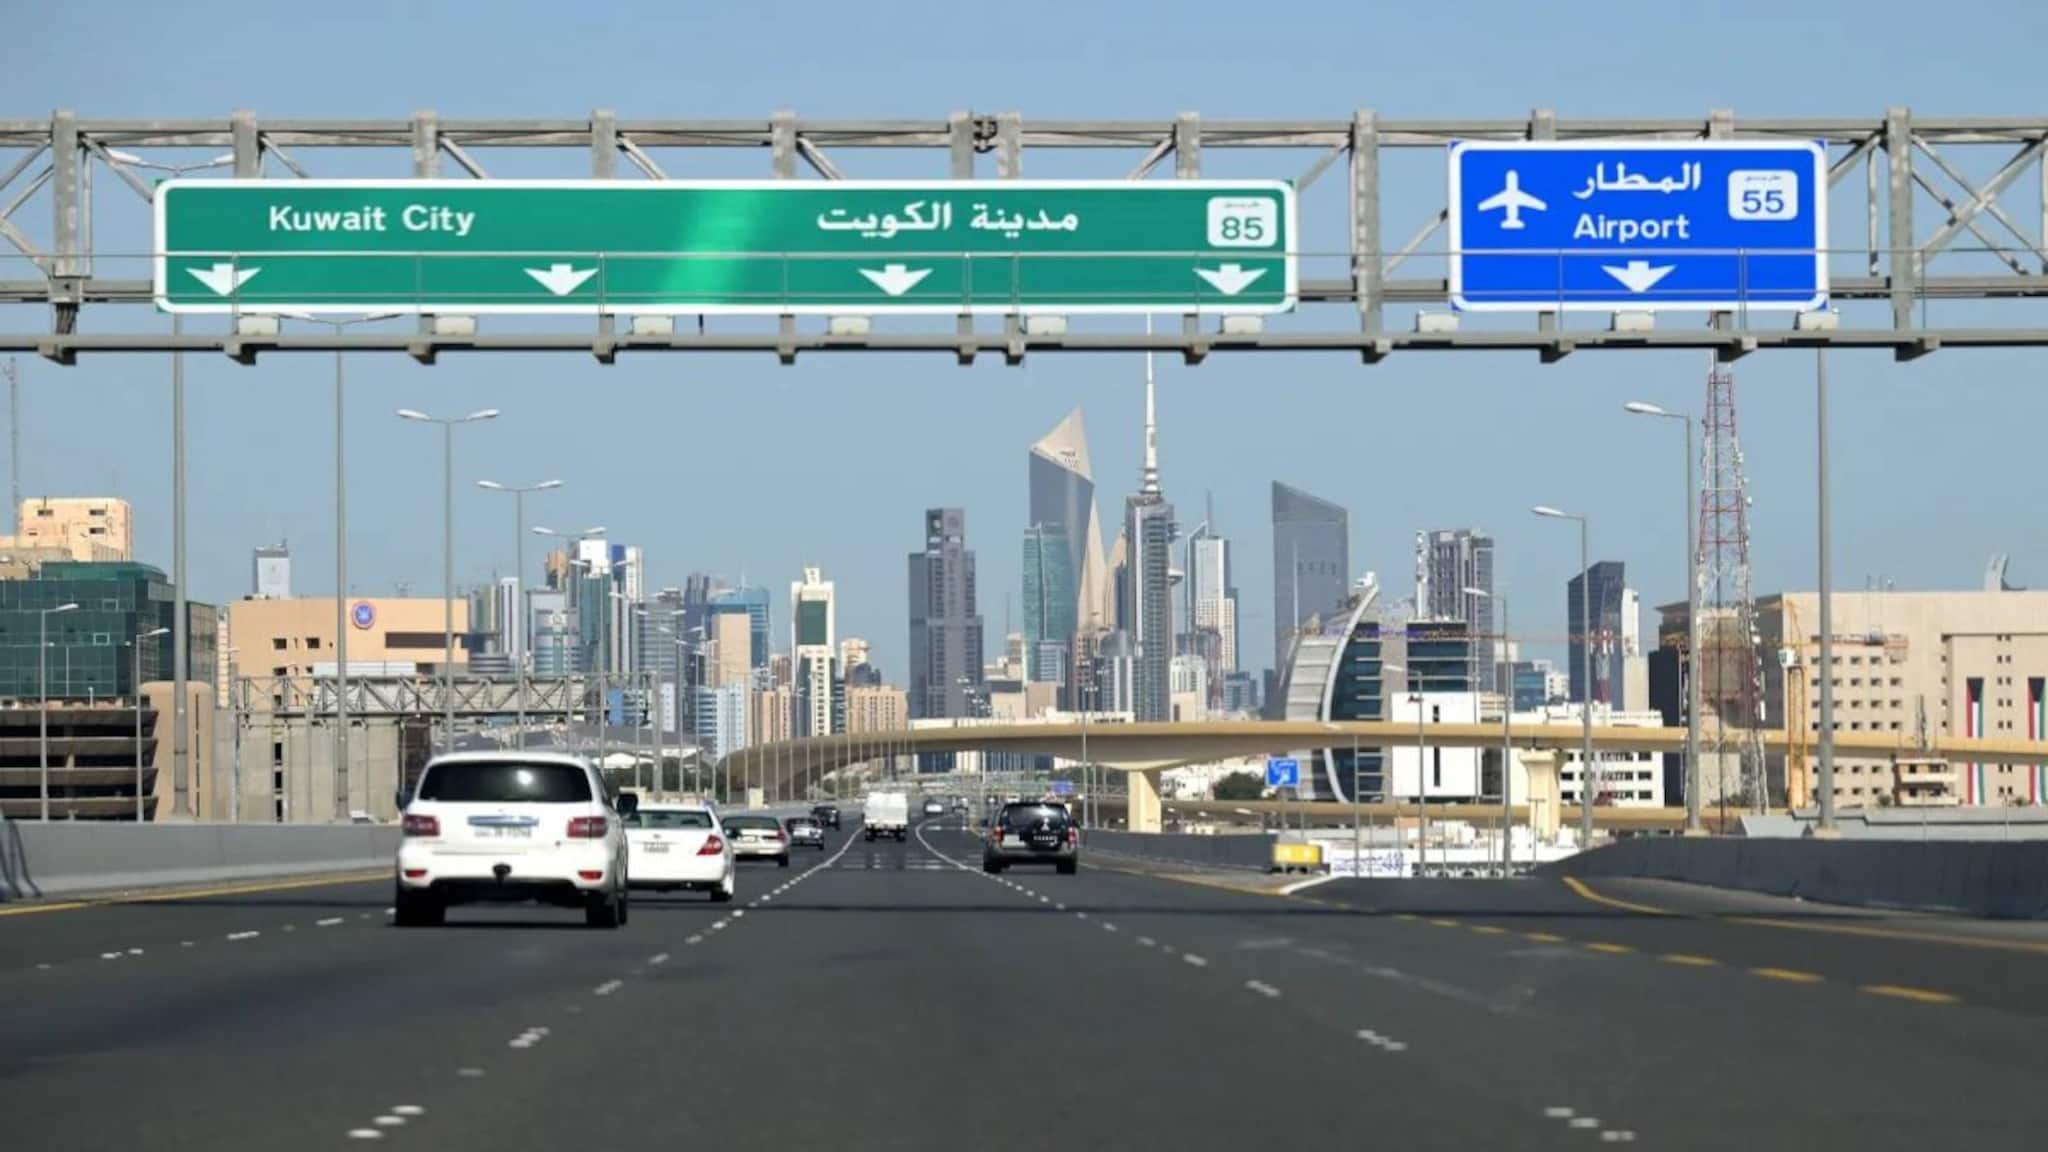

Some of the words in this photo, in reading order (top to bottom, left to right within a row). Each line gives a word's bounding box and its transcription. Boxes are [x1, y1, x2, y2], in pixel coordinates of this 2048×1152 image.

[1573, 161, 1702, 199] المطار
[1742, 189, 1785, 214] 55
[268, 204, 386, 231] Kuwait
[402, 204, 475, 236] City
[817, 201, 952, 239] الكويت
[970, 203, 1079, 238] مدينة
[1220, 215, 1264, 241] 85
[1573, 213, 1690, 243] Airport
